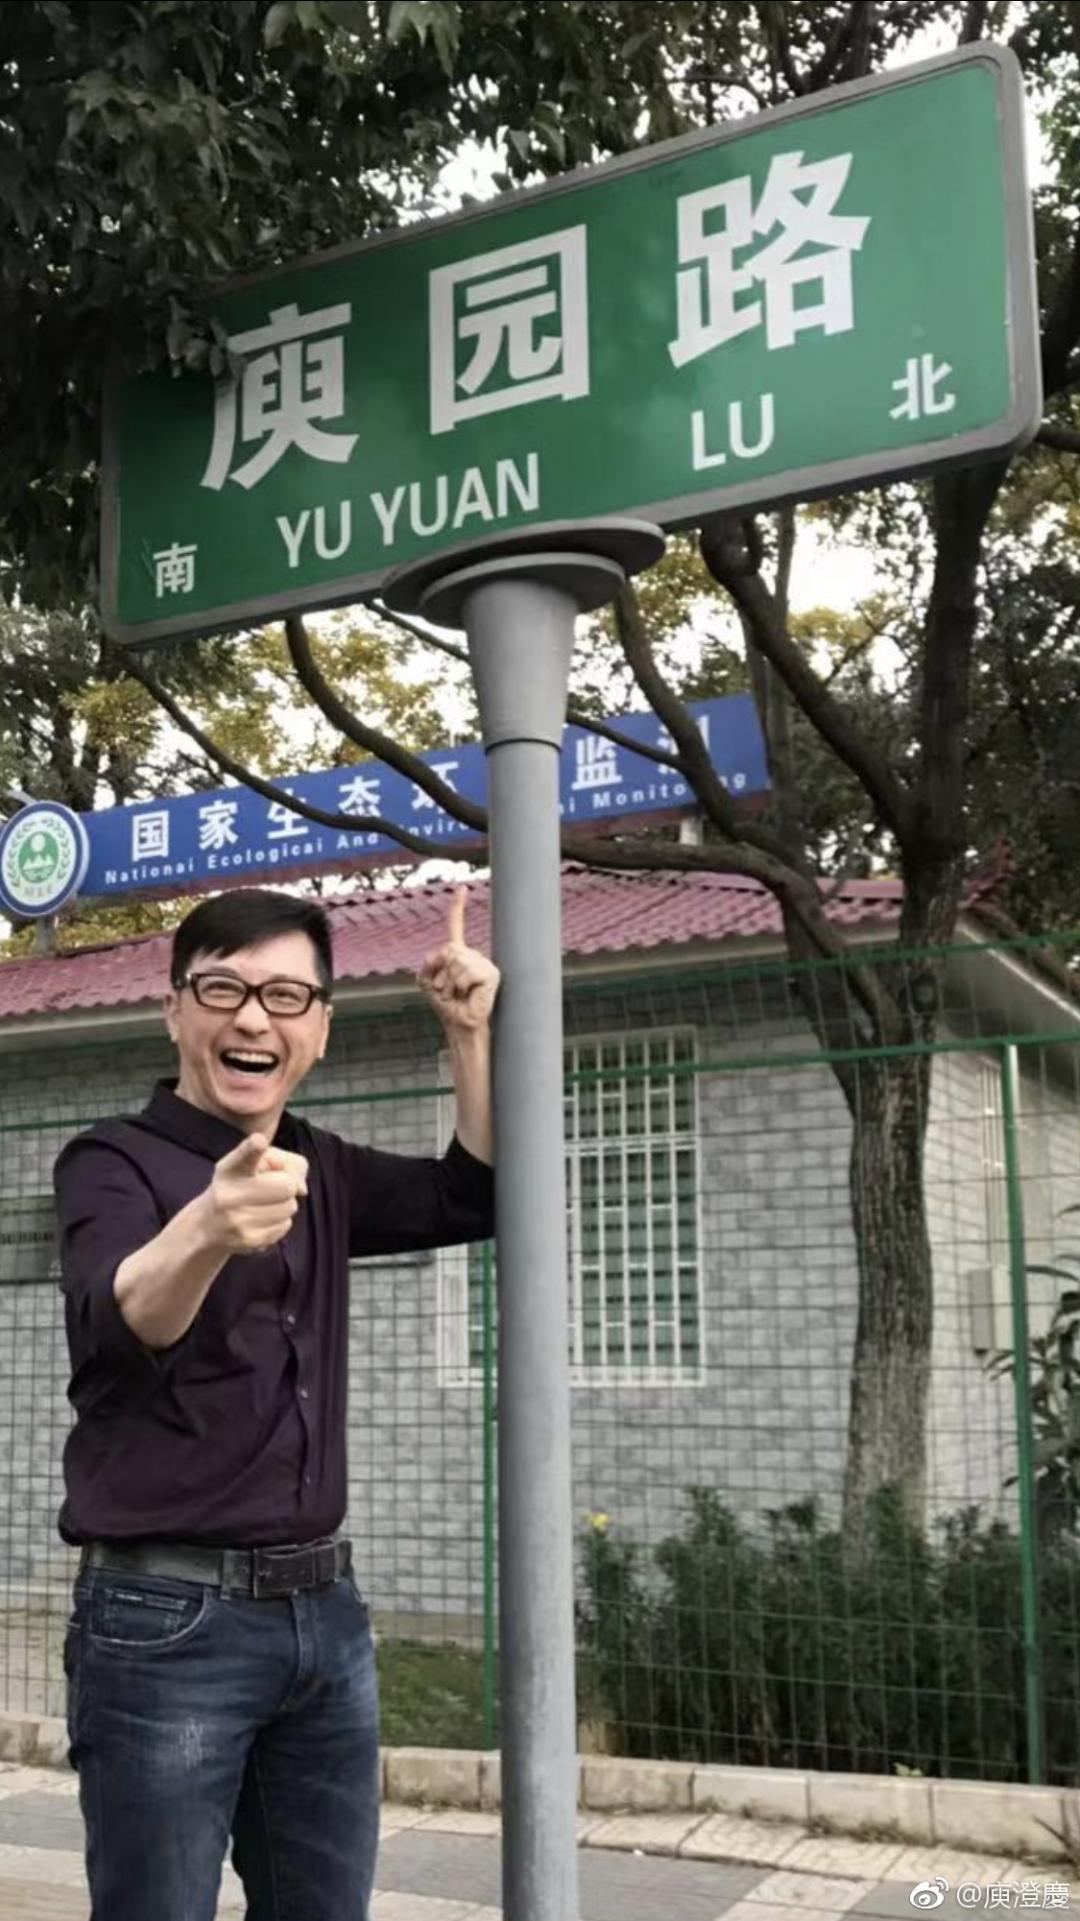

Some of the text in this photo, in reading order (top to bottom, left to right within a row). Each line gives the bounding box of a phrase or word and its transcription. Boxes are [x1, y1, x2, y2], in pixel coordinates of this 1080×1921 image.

[889, 353, 956, 420] 北
[276, 393, 775, 568] YU YUAN LU
[152, 541, 198, 598] 南
[105, 857, 194, 885] National
[207, 837, 323, 869] Ecological
